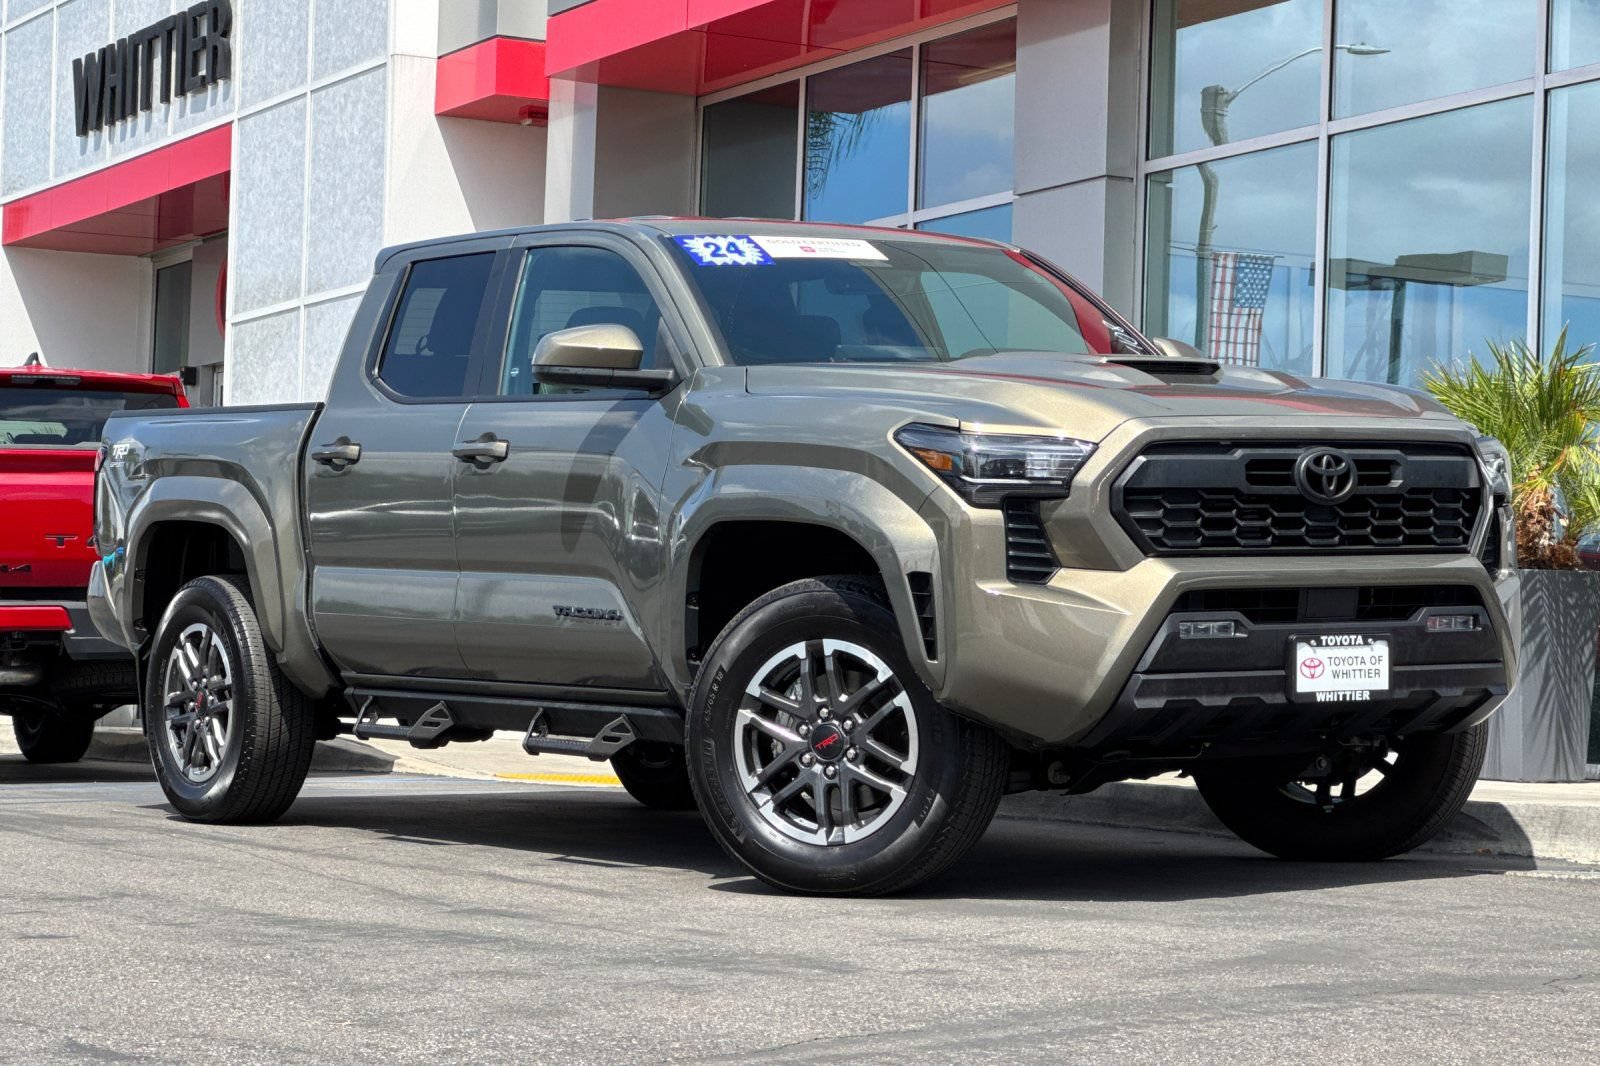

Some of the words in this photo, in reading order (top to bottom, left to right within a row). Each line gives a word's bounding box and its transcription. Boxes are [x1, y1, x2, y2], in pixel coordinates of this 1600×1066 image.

[72, 0, 233, 137] WHITTIER
[703, 242, 746, 258] 24
[112, 444, 130, 459] TRD
[1320, 635, 1364, 646] TOYOTA
[1327, 656, 1367, 667] TOYOTA
[1369, 655, 1384, 666] OF
[1331, 669, 1381, 679] WHITTIER
[1315, 691, 1371, 702] WHITTIER
